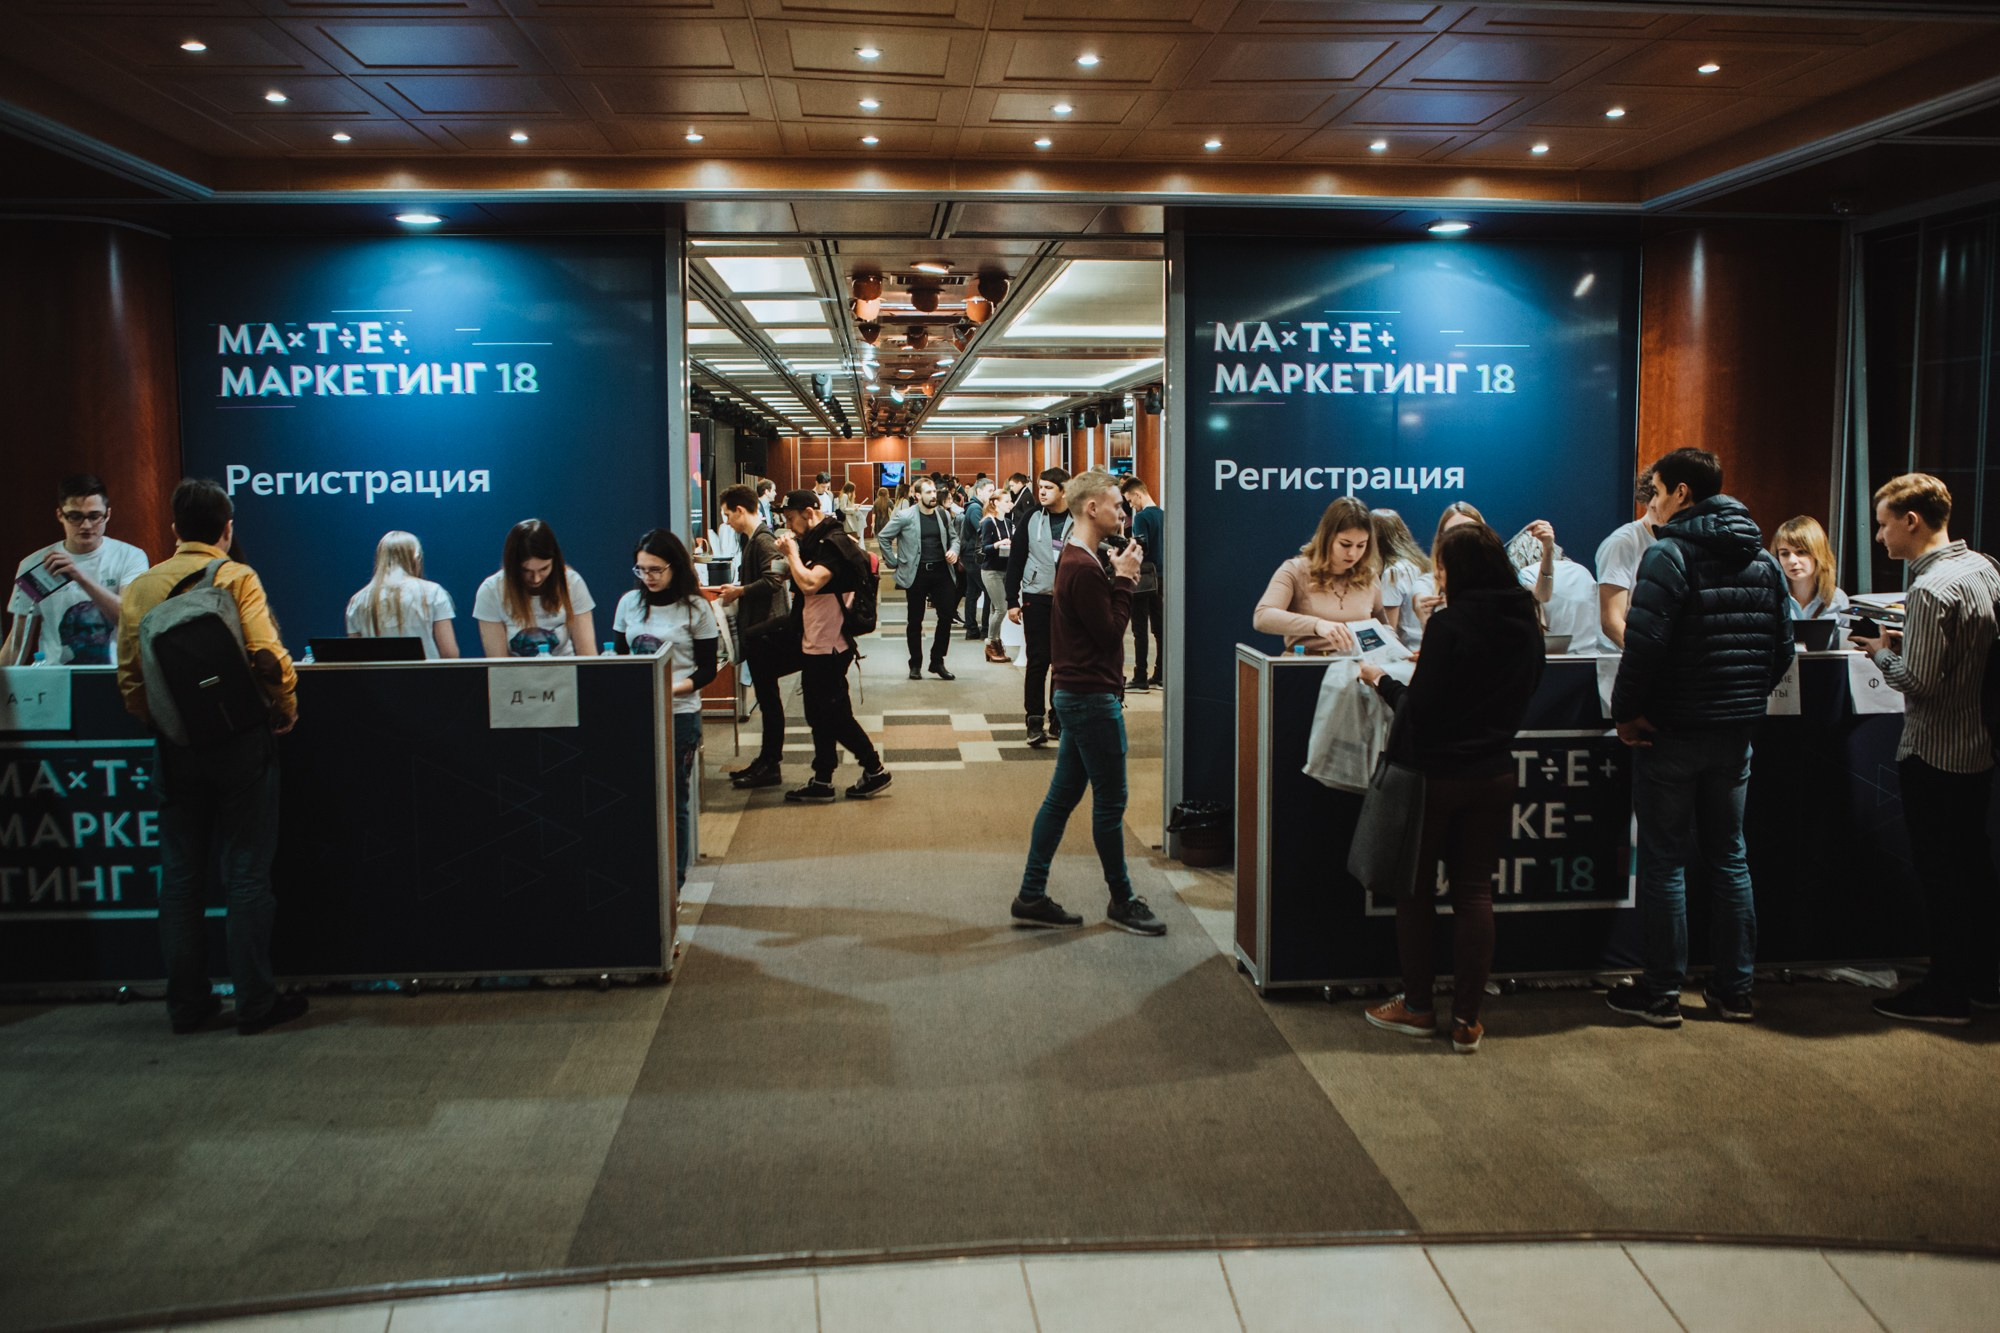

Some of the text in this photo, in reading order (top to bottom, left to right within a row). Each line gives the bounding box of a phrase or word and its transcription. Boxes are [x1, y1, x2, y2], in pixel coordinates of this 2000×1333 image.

[218, 362, 540, 397] МАРКЕТИНГ 18
[1213, 362, 1517, 394] МАРКЕТИНГ 18
[226, 464, 491, 504] Регистрация
[1214, 459, 1465, 497] Регистрация
[0, 811, 160, 848] МАРКЕ
[1510, 802, 1593, 839] КЕ-
[1550, 855, 1596, 893] 18
